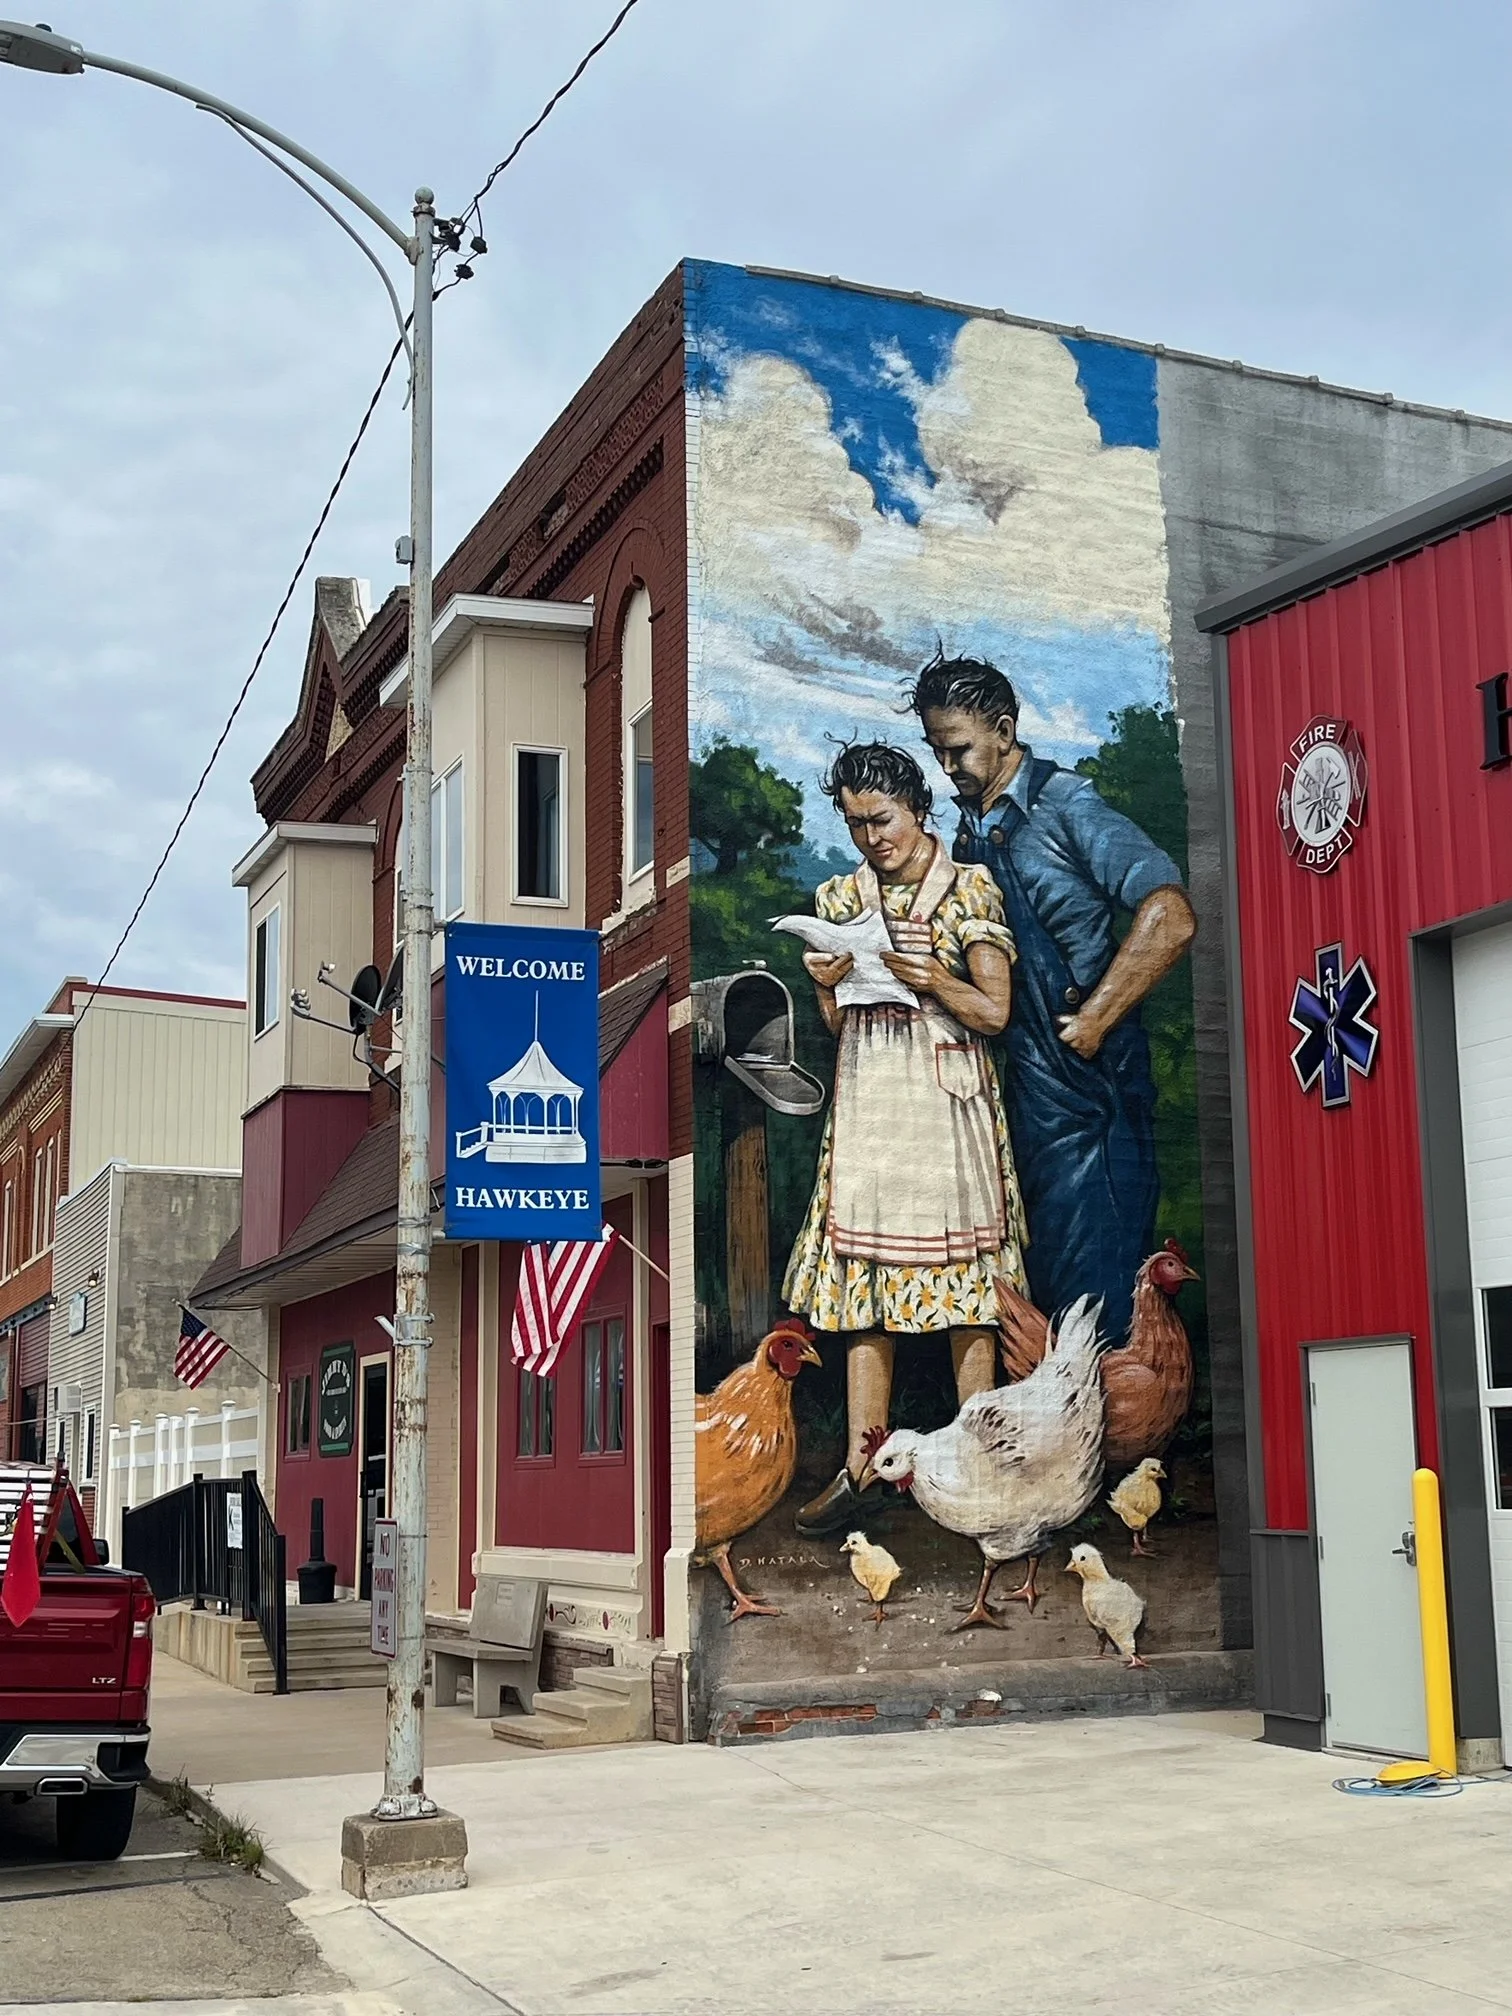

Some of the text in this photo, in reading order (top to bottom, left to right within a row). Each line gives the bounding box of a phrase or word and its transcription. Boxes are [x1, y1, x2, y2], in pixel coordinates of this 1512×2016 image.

[1299, 724, 1336, 753] FIRE
[1305, 834, 1342, 864] DEPT
[456, 955, 585, 981] WELCOME
[455, 1187, 589, 1210] HAWKEYE
[380, 1533, 390, 1558] NO
[374, 1567, 393, 1593] PARKING
[378, 1600, 388, 1619] ANY
[377, 1624, 389, 1645] TIME
